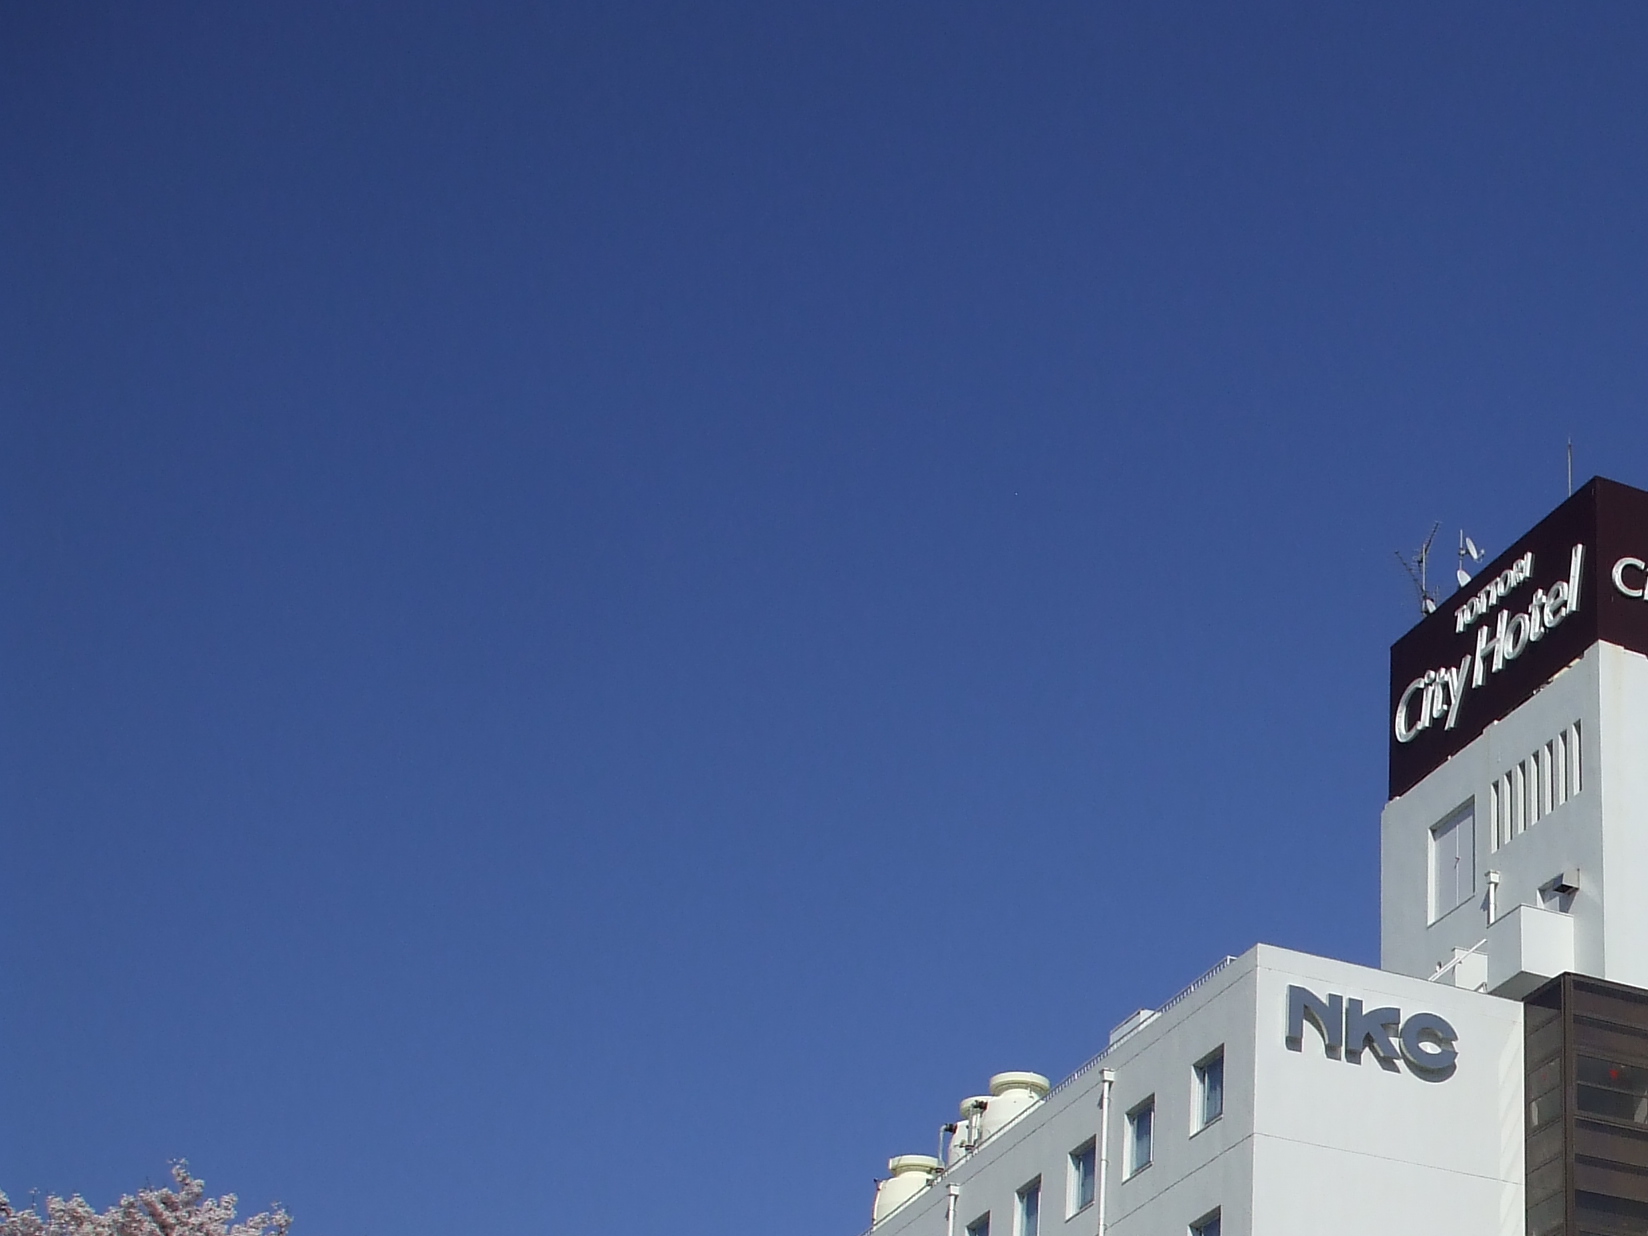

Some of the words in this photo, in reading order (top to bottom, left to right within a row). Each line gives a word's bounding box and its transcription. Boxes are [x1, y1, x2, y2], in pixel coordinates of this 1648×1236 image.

[1395, 653, 1472, 744] City
[1471, 542, 1586, 689] Hotel
[1454, 551, 1534, 634] TOTTORI
[1285, 983, 1459, 1084] NKC
